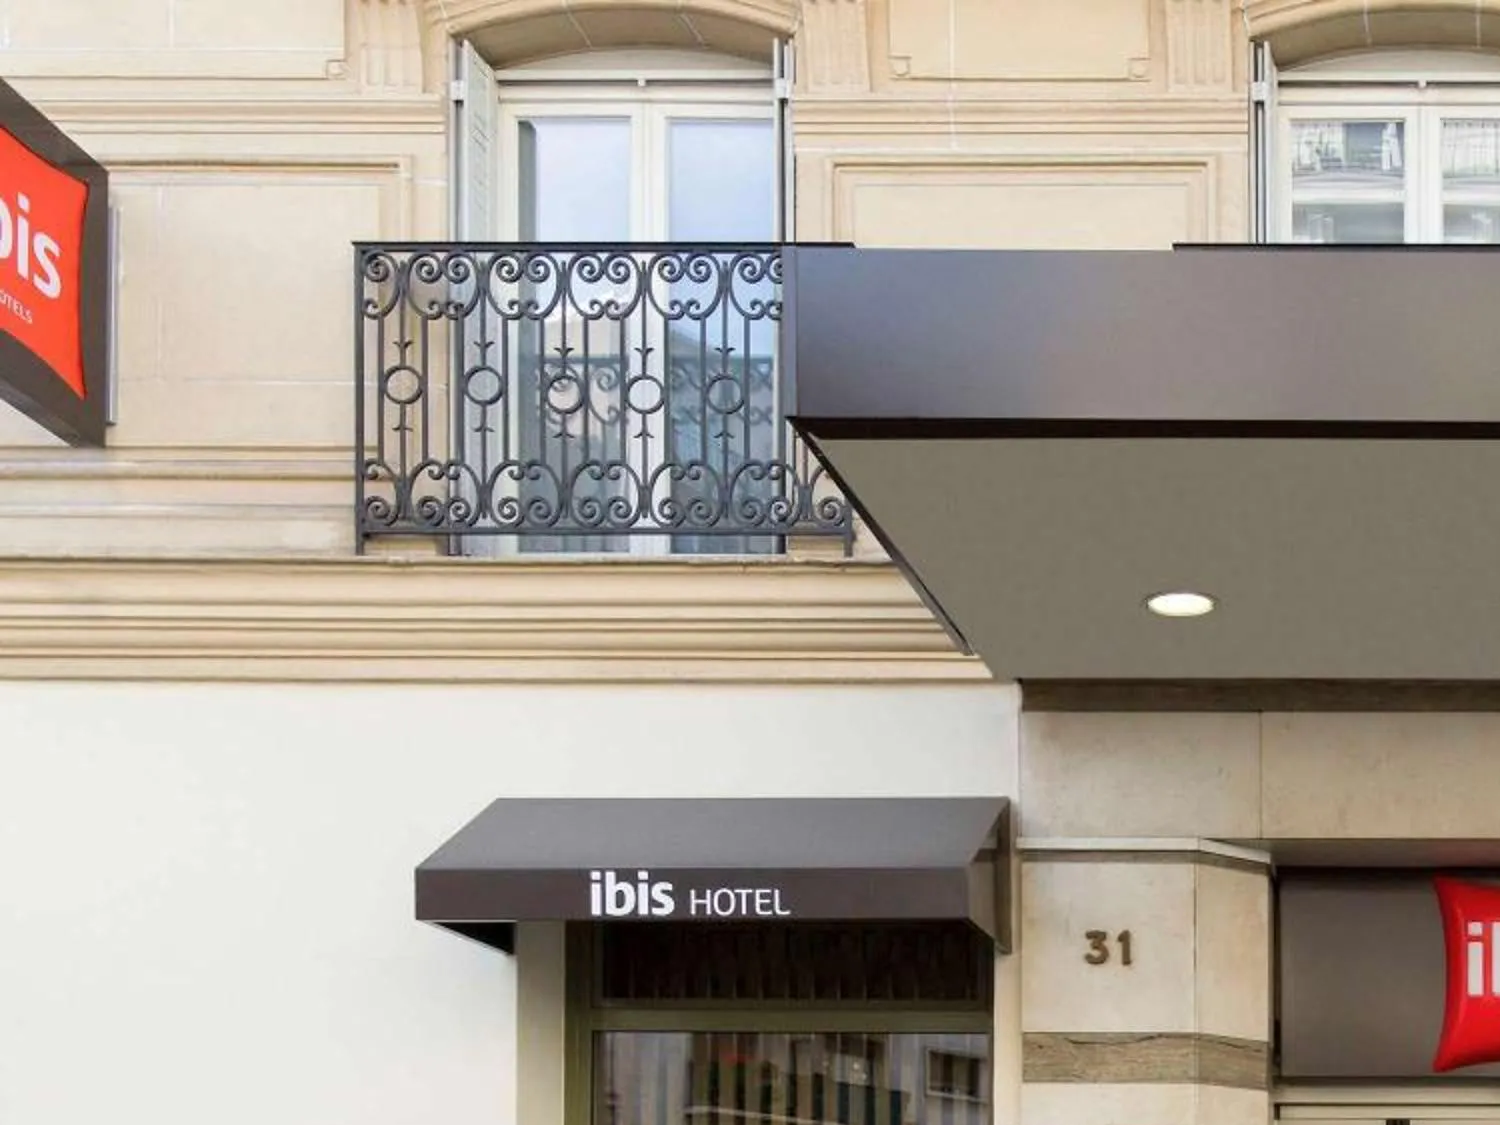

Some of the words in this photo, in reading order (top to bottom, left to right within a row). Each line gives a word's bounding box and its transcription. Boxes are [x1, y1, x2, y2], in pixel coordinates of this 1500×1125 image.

[0, 191, 62, 300] is
[0, 289, 33, 325] TELS
[590, 870, 676, 917] ibis
[689, 887, 792, 916] HOTEL
[1084, 929, 1132, 966] 31
